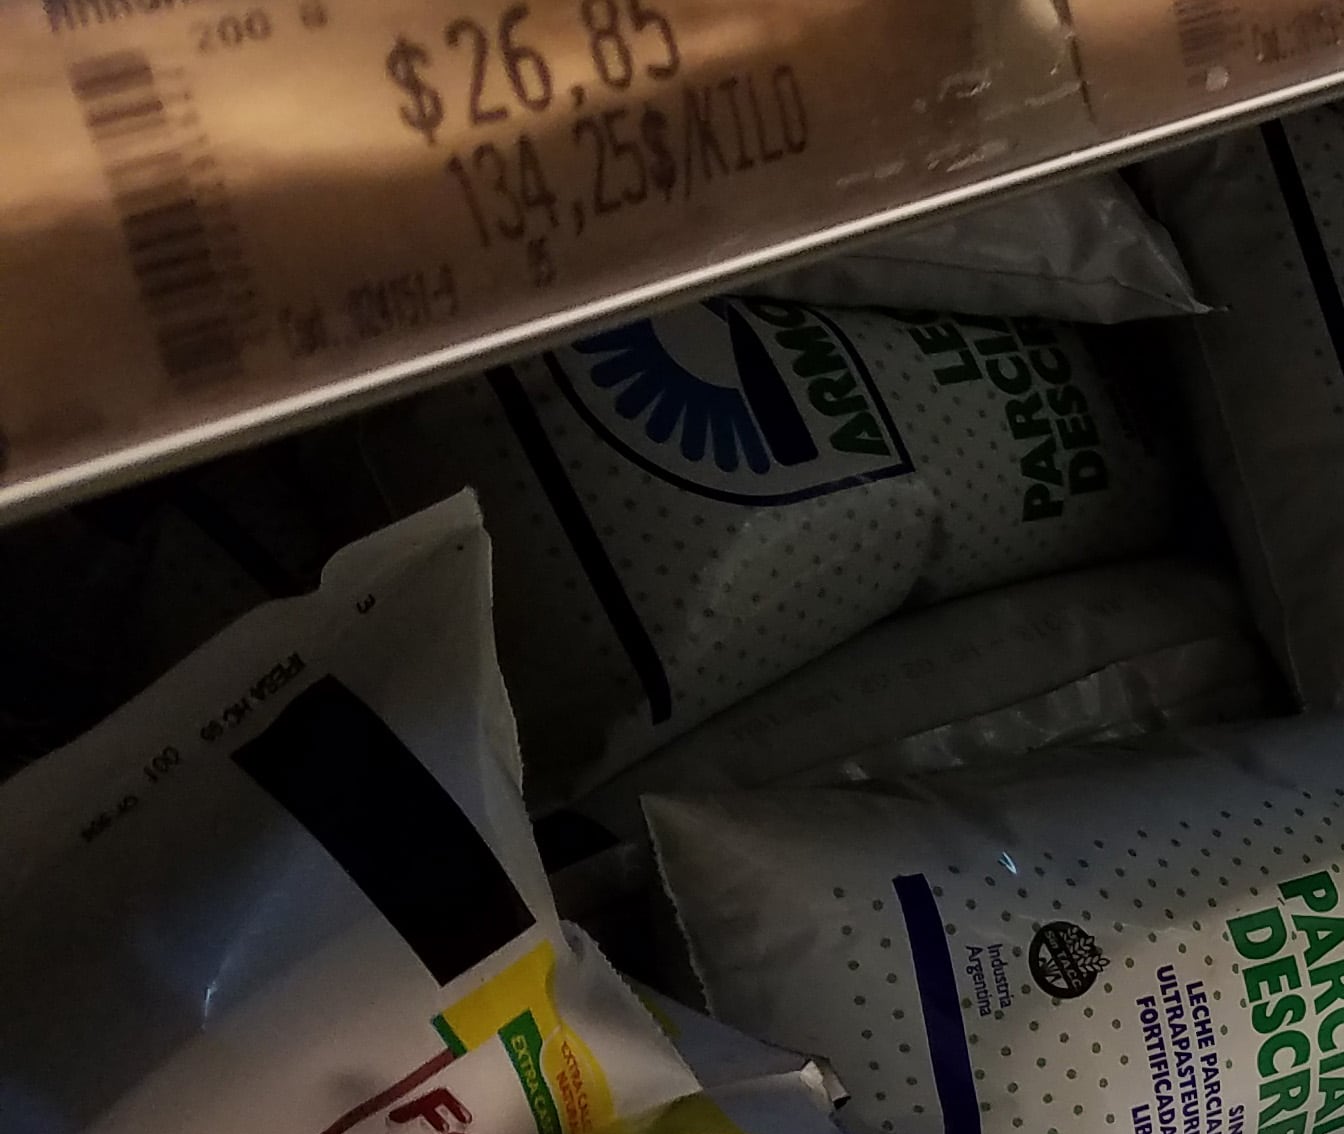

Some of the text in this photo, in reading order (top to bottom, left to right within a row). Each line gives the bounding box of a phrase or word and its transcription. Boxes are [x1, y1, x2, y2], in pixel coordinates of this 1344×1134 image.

[964, 945, 993, 1018] Argentina
[986, 943, 1015, 1009] Industria
[1186, 981, 1217, 1049] LECHE
[508, 1033, 541, 1092] EXTRA
